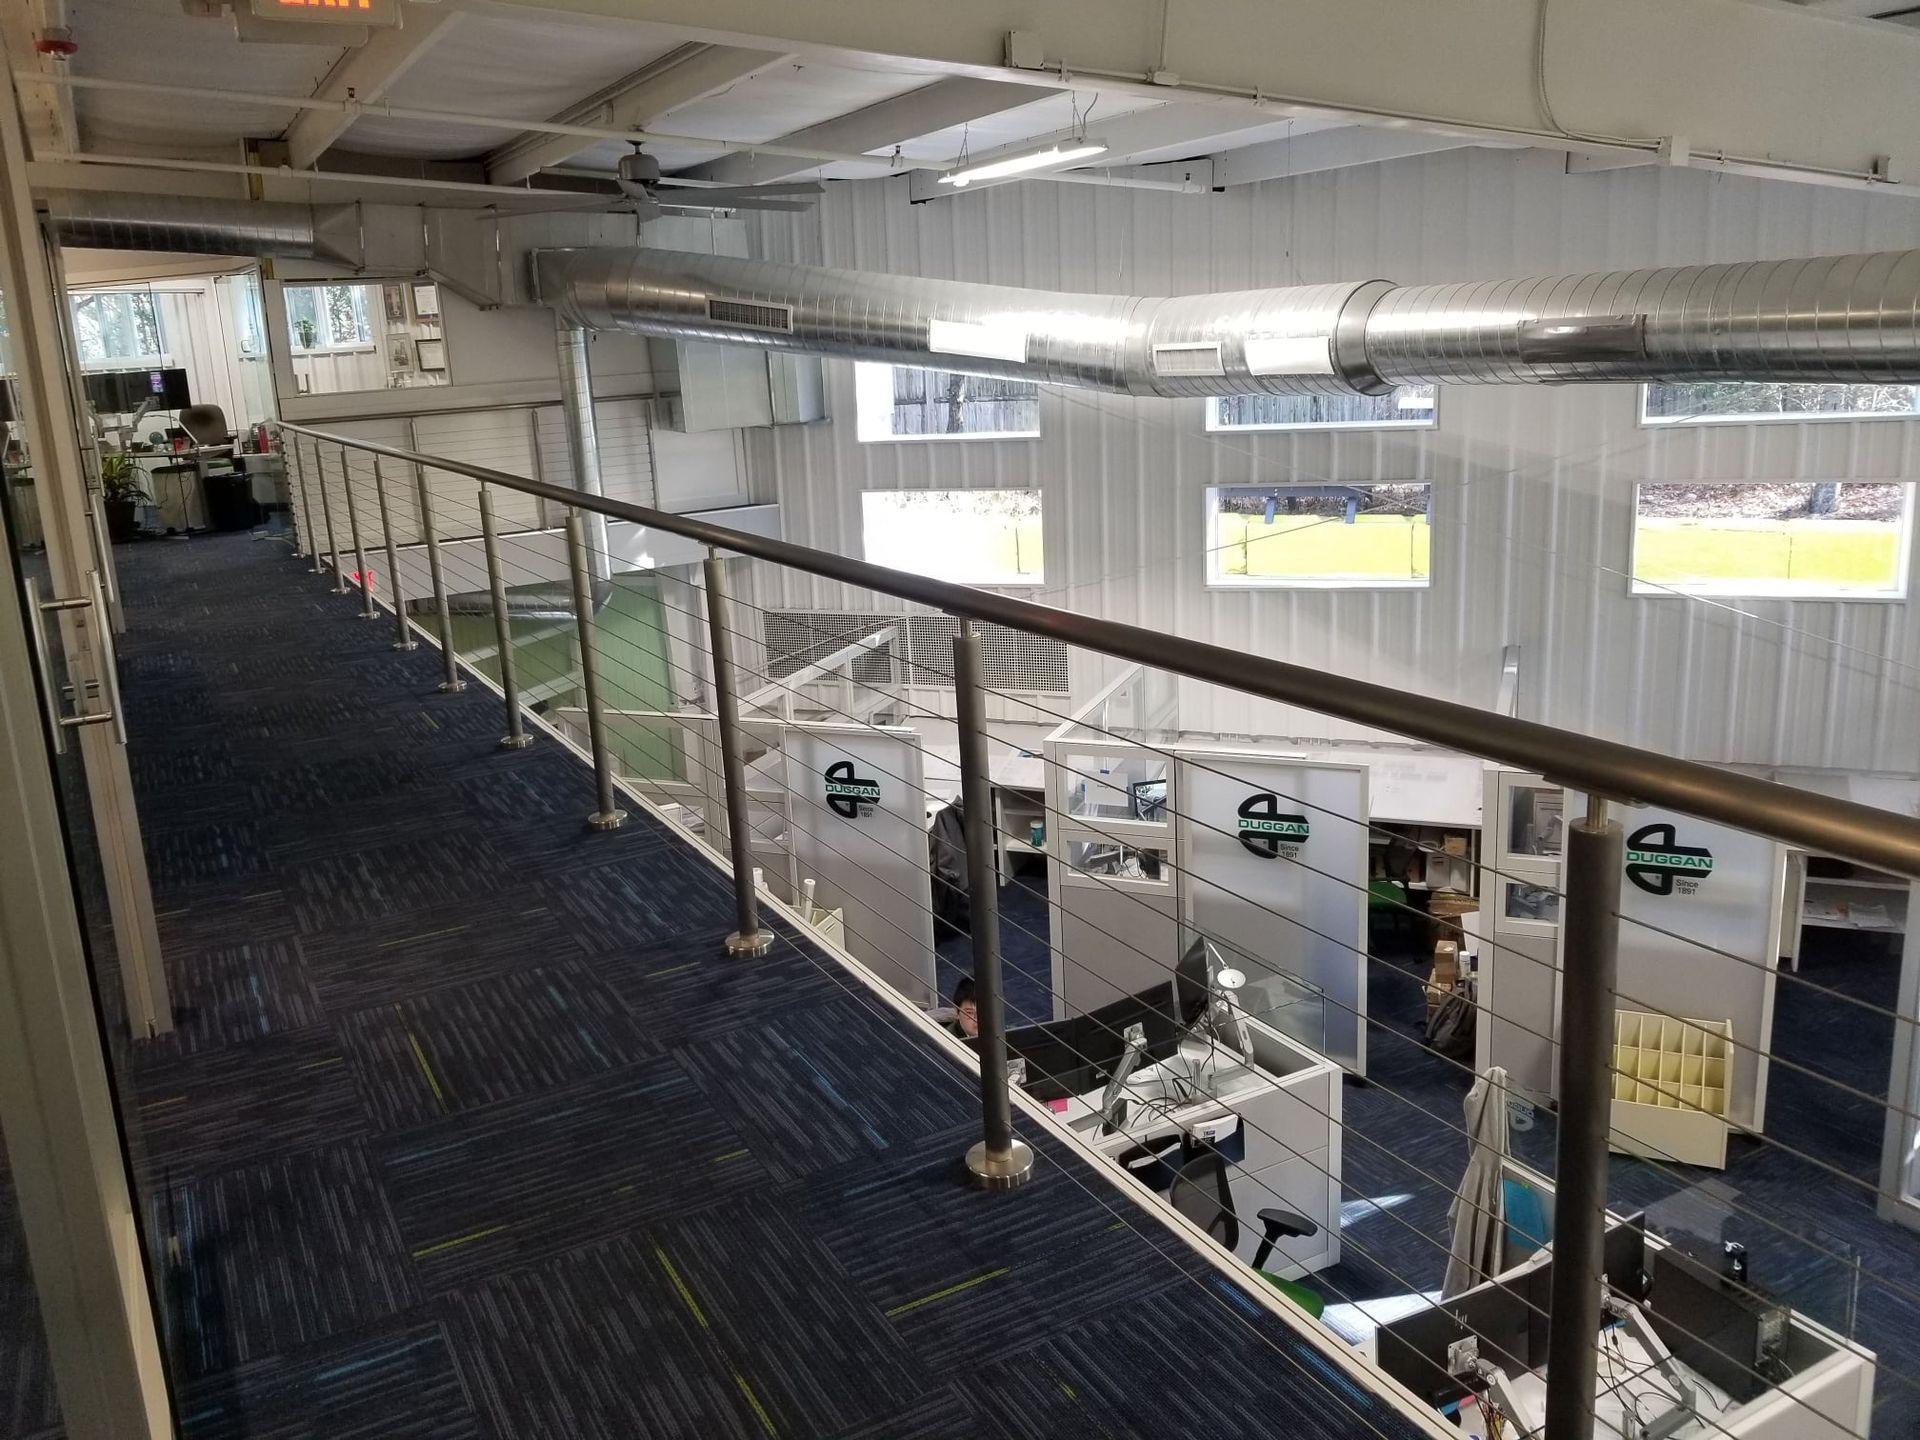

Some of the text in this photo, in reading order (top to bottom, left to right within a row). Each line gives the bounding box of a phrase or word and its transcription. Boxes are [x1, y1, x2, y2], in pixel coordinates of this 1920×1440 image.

[825, 784, 880, 796] DUGGAN
[1238, 819, 1310, 834] DUGGAN
[1280, 844, 1299, 852] Since
[1626, 851, 1712, 869] DUGGAN
[1675, 879, 1699, 888] Since
[1678, 887, 1696, 896] 1891
